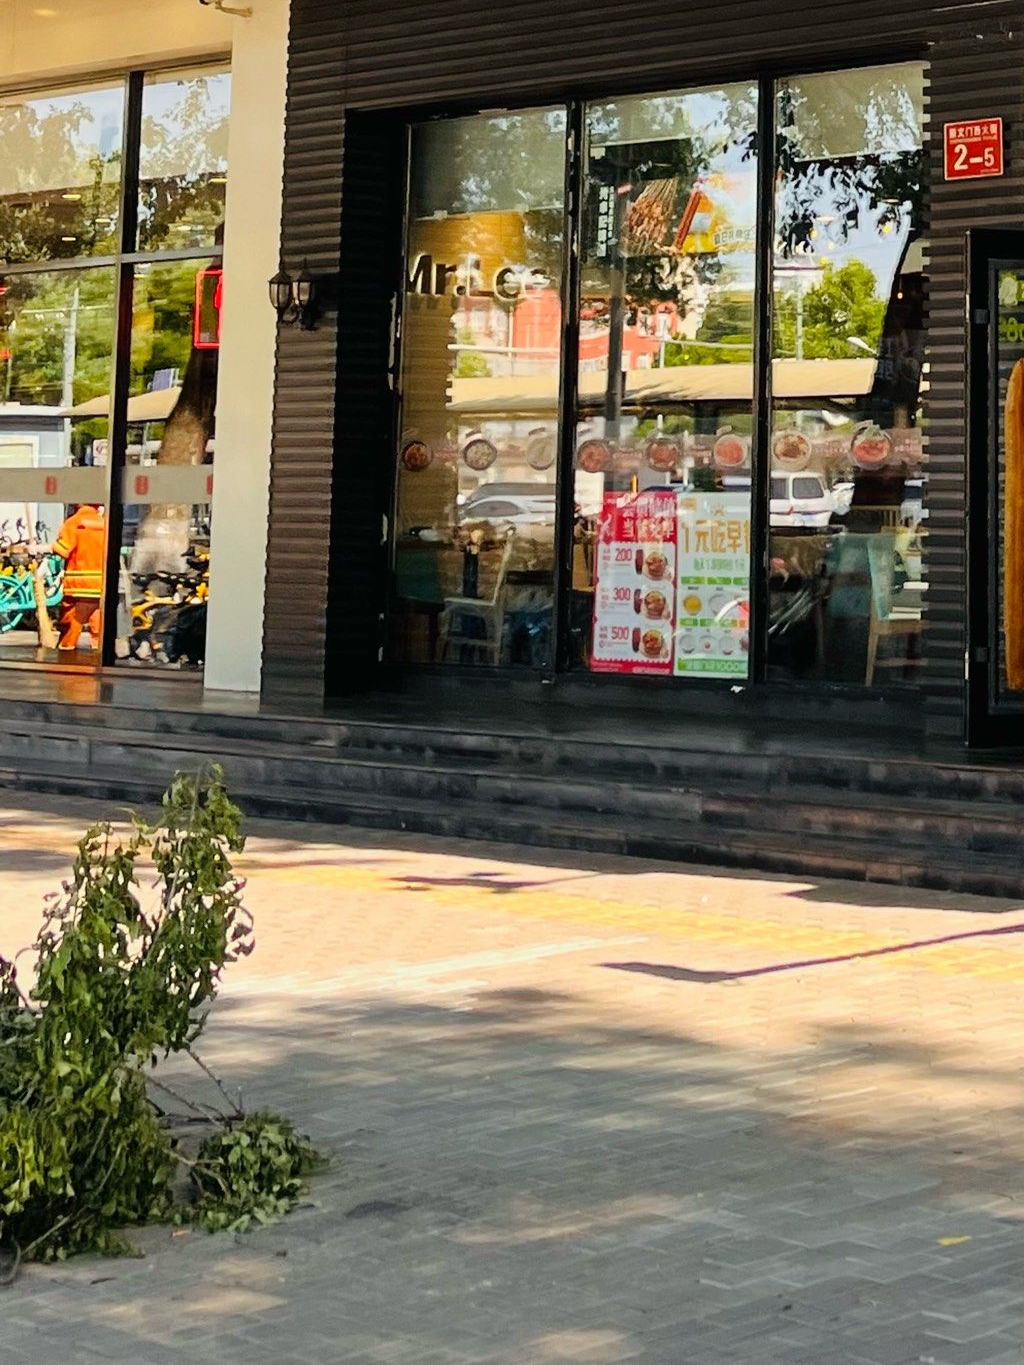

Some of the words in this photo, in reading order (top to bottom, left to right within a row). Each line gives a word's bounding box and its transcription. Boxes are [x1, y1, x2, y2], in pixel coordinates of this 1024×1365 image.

[953, 143, 995, 171] 2-5
[615, 548, 633, 562] 200
[613, 587, 631, 602] 300
[611, 627, 630, 641] 500
